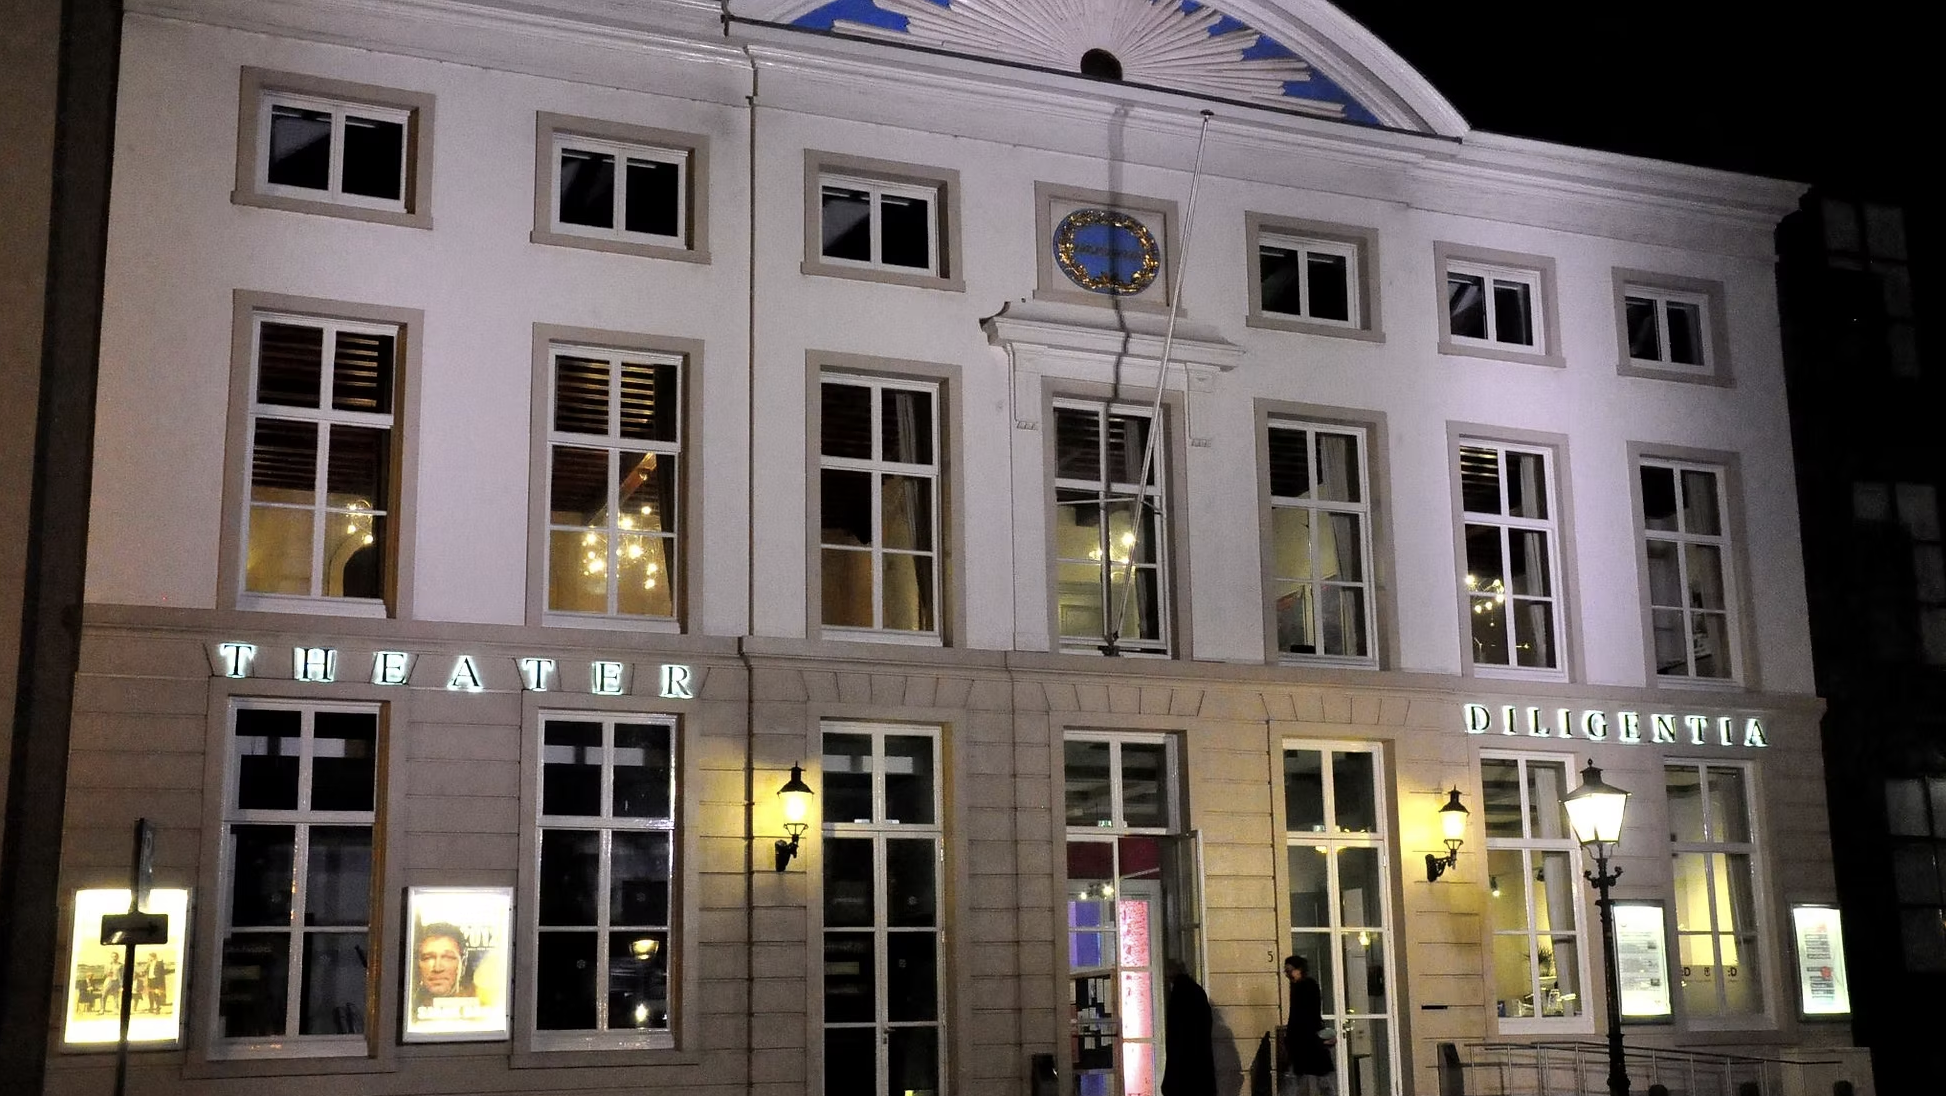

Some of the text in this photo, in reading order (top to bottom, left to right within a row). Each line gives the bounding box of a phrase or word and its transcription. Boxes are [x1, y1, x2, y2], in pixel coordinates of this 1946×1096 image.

[221, 643, 693, 698] THEATER
[1466, 703, 1768, 747] DILIGENTIA
[1267, 950, 1274, 963] 5
